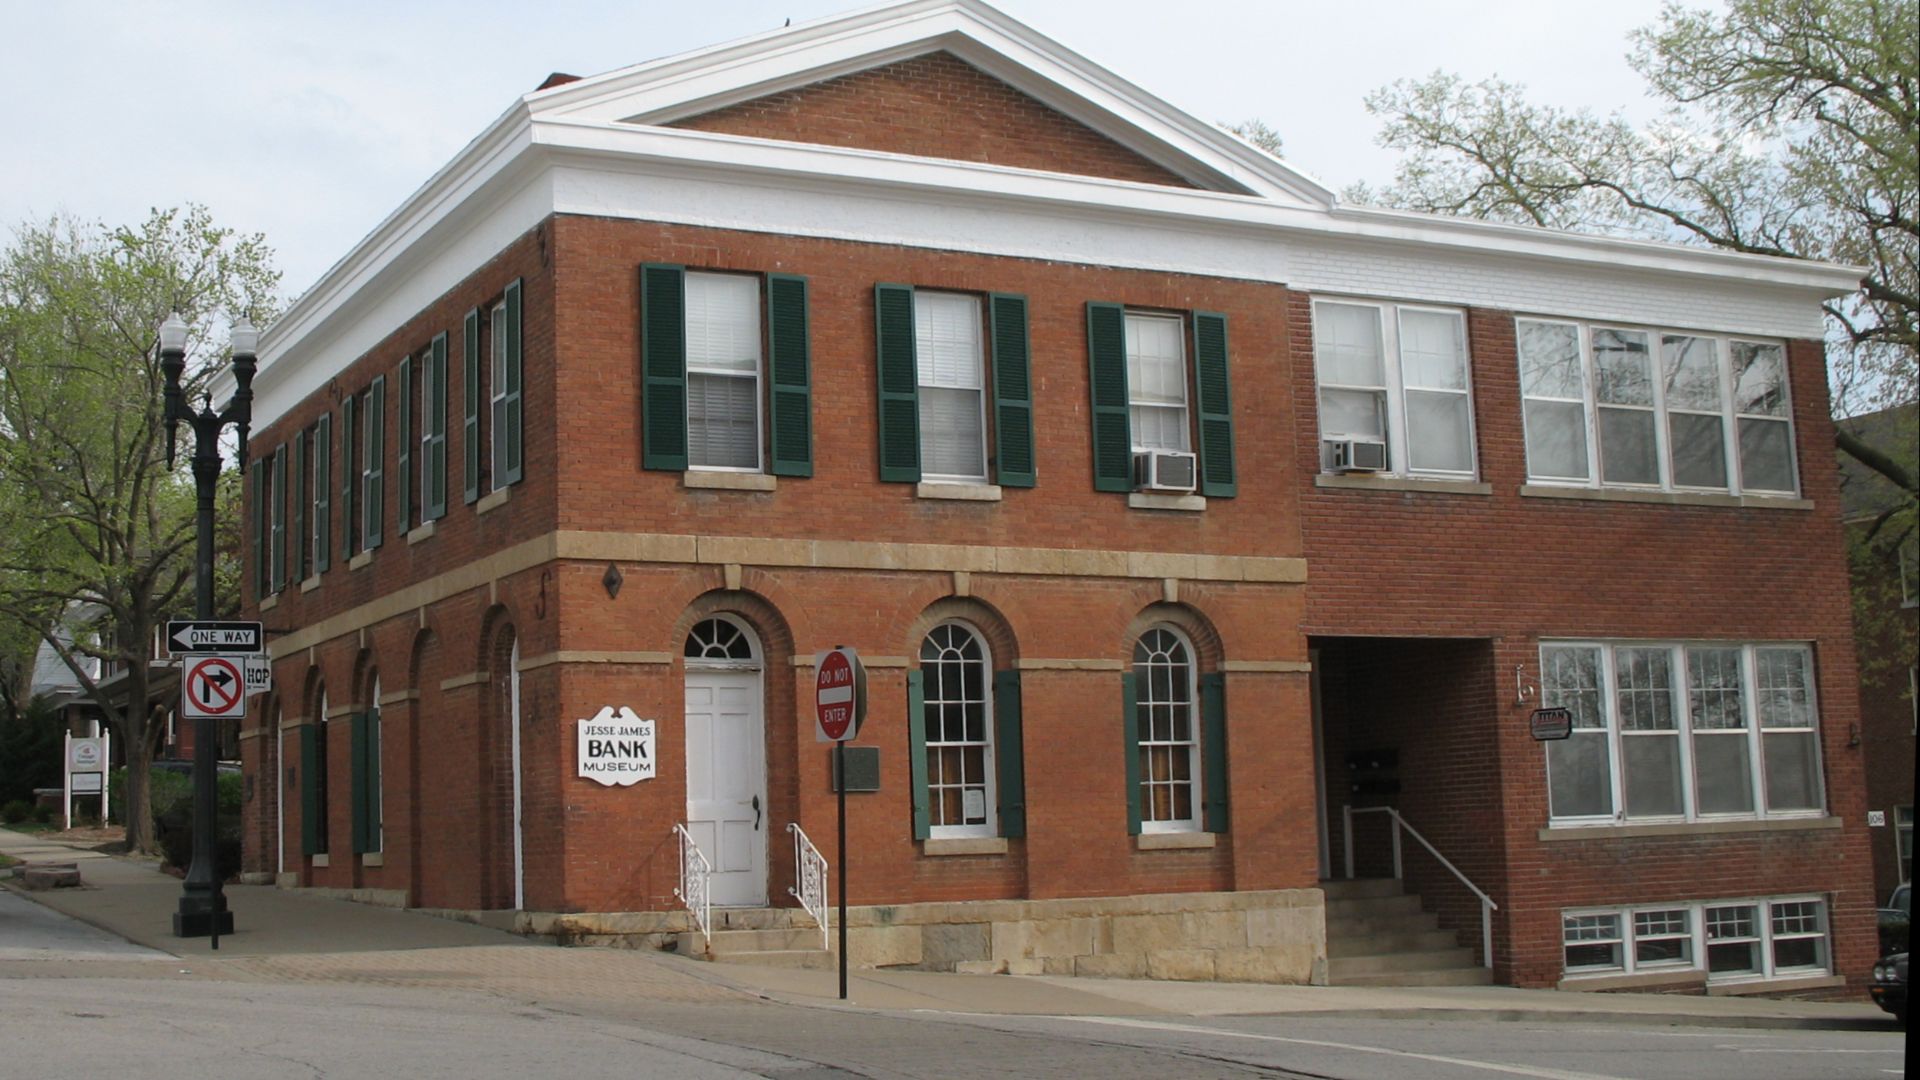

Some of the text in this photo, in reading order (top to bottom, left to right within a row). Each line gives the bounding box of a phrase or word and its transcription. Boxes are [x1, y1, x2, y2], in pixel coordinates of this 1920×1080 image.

[190, 631, 251, 643] ONE WAY
[821, 667, 848, 684] DO NOT
[824, 708, 846, 723] ENTER
[1538, 711, 1565, 720] TITAN
[584, 726, 651, 736] JESSE JAMES
[588, 740, 647, 758] BANK
[584, 762, 651, 772] MUSEUM
